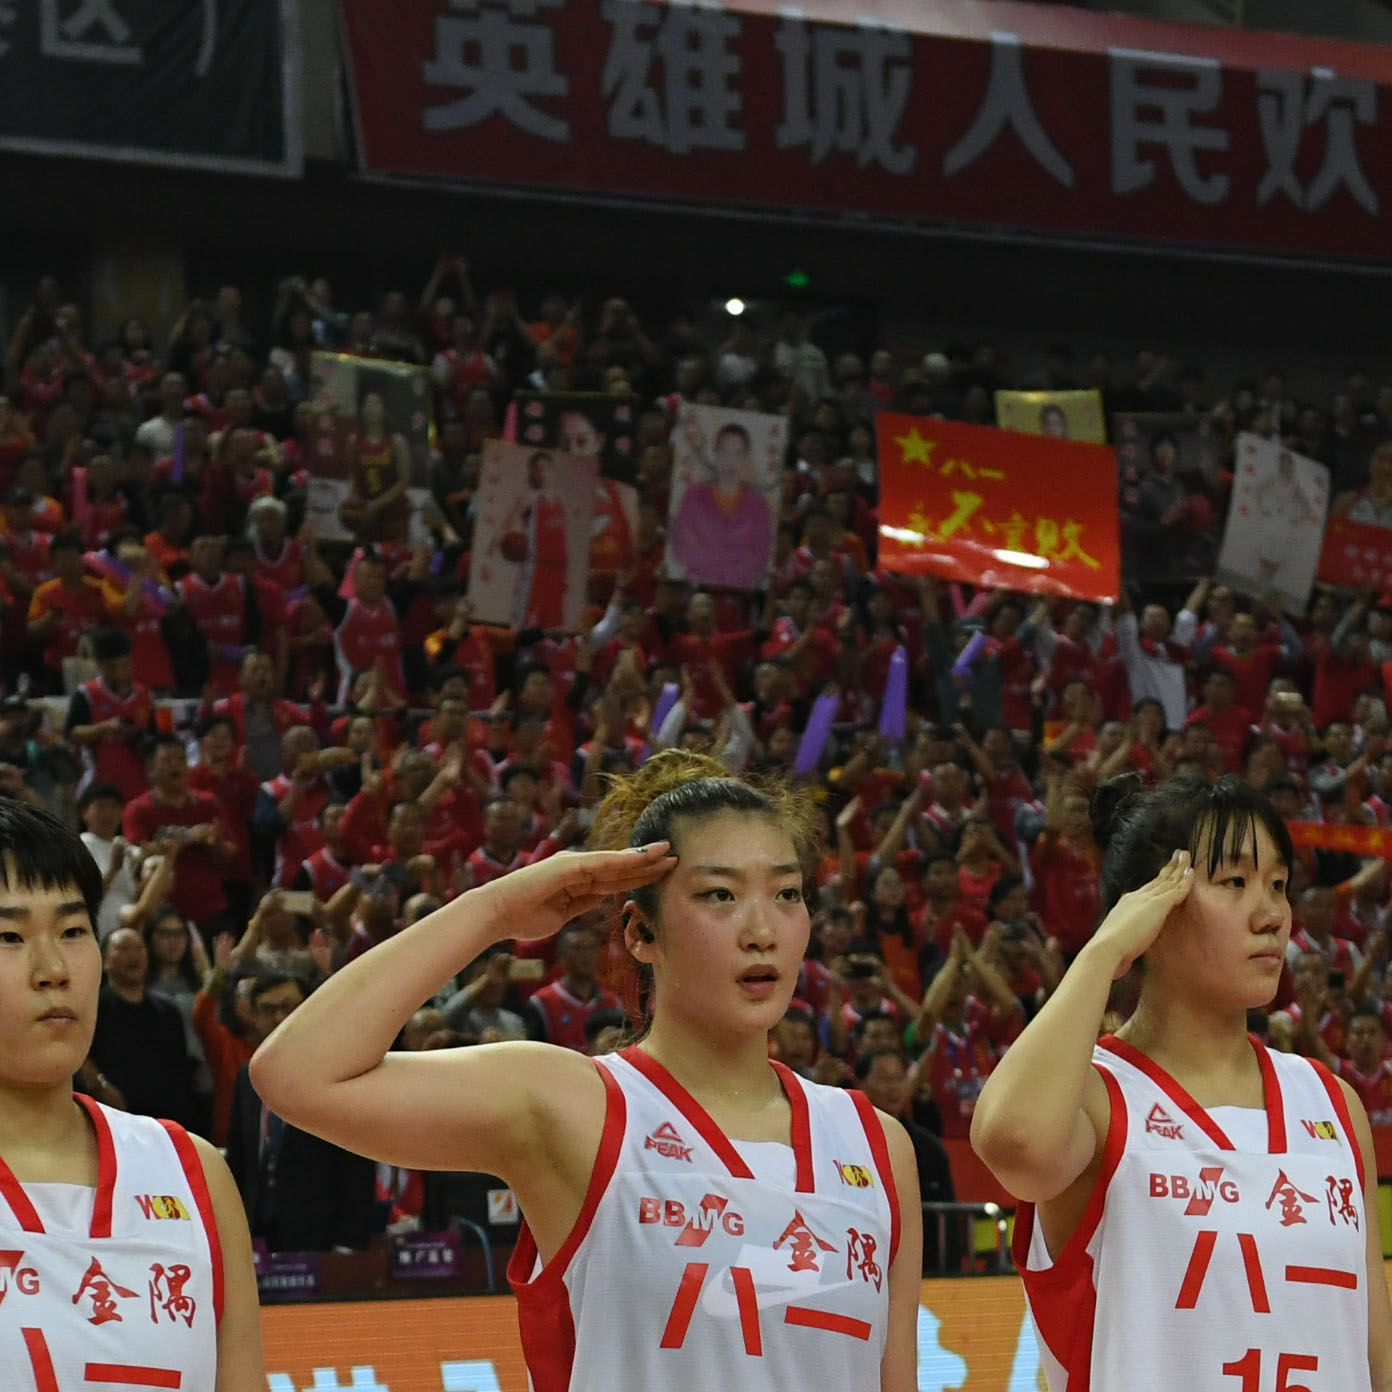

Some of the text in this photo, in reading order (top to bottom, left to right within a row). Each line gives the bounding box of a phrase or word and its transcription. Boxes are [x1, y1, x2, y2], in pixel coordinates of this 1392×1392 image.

[644, 1133, 694, 1163] PEAK
[638, 1195, 745, 1242] BBMG
[1149, 1170, 1240, 1210] BBMG
[1265, 1167, 1360, 1233] 金隅
[772, 1210, 883, 1295] 金隅
[1175, 1230, 1357, 1314] 八一
[72, 1256, 196, 1329] 金隅
[659, 1262, 873, 1356] 八一
